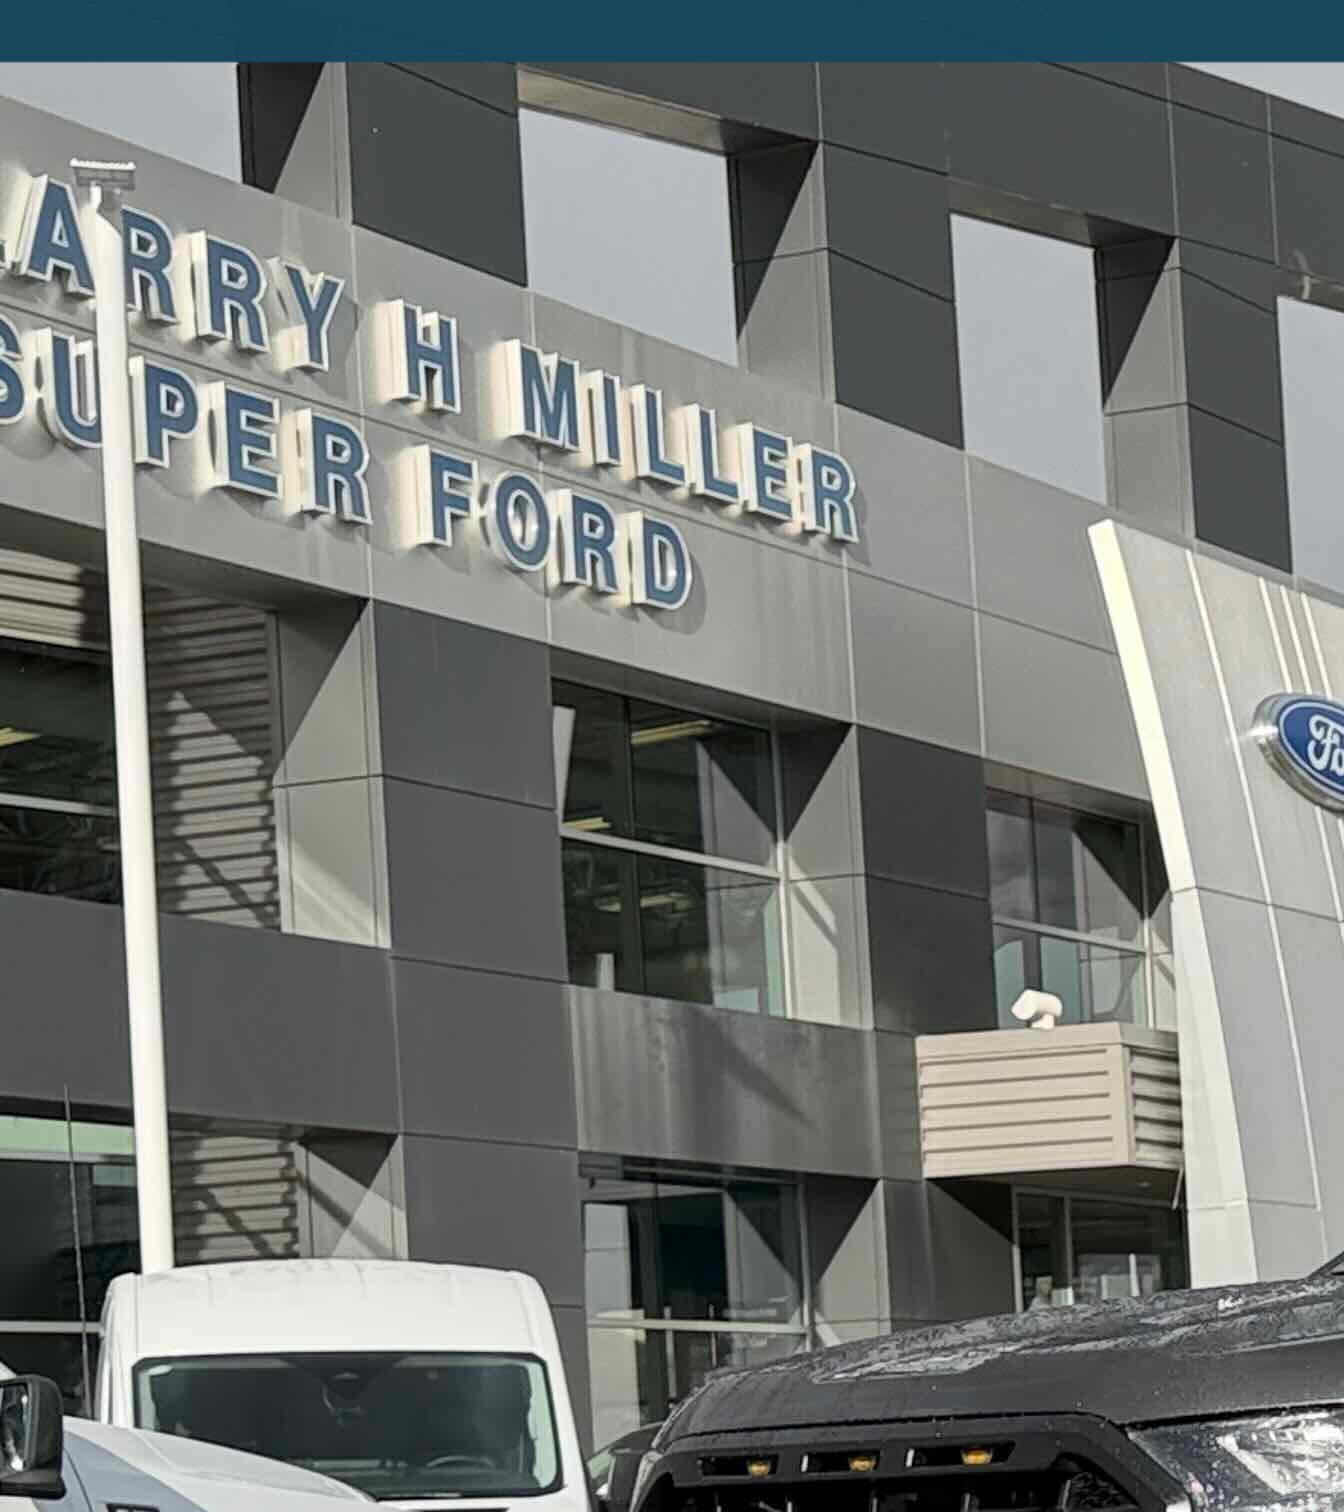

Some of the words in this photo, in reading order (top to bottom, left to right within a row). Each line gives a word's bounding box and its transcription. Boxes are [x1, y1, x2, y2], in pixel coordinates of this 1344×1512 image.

[0, 174, 345, 372] ARRY
[394, 298, 461, 414] H
[506, 338, 860, 544] MILLER
[416, 443, 693, 610] FORD
